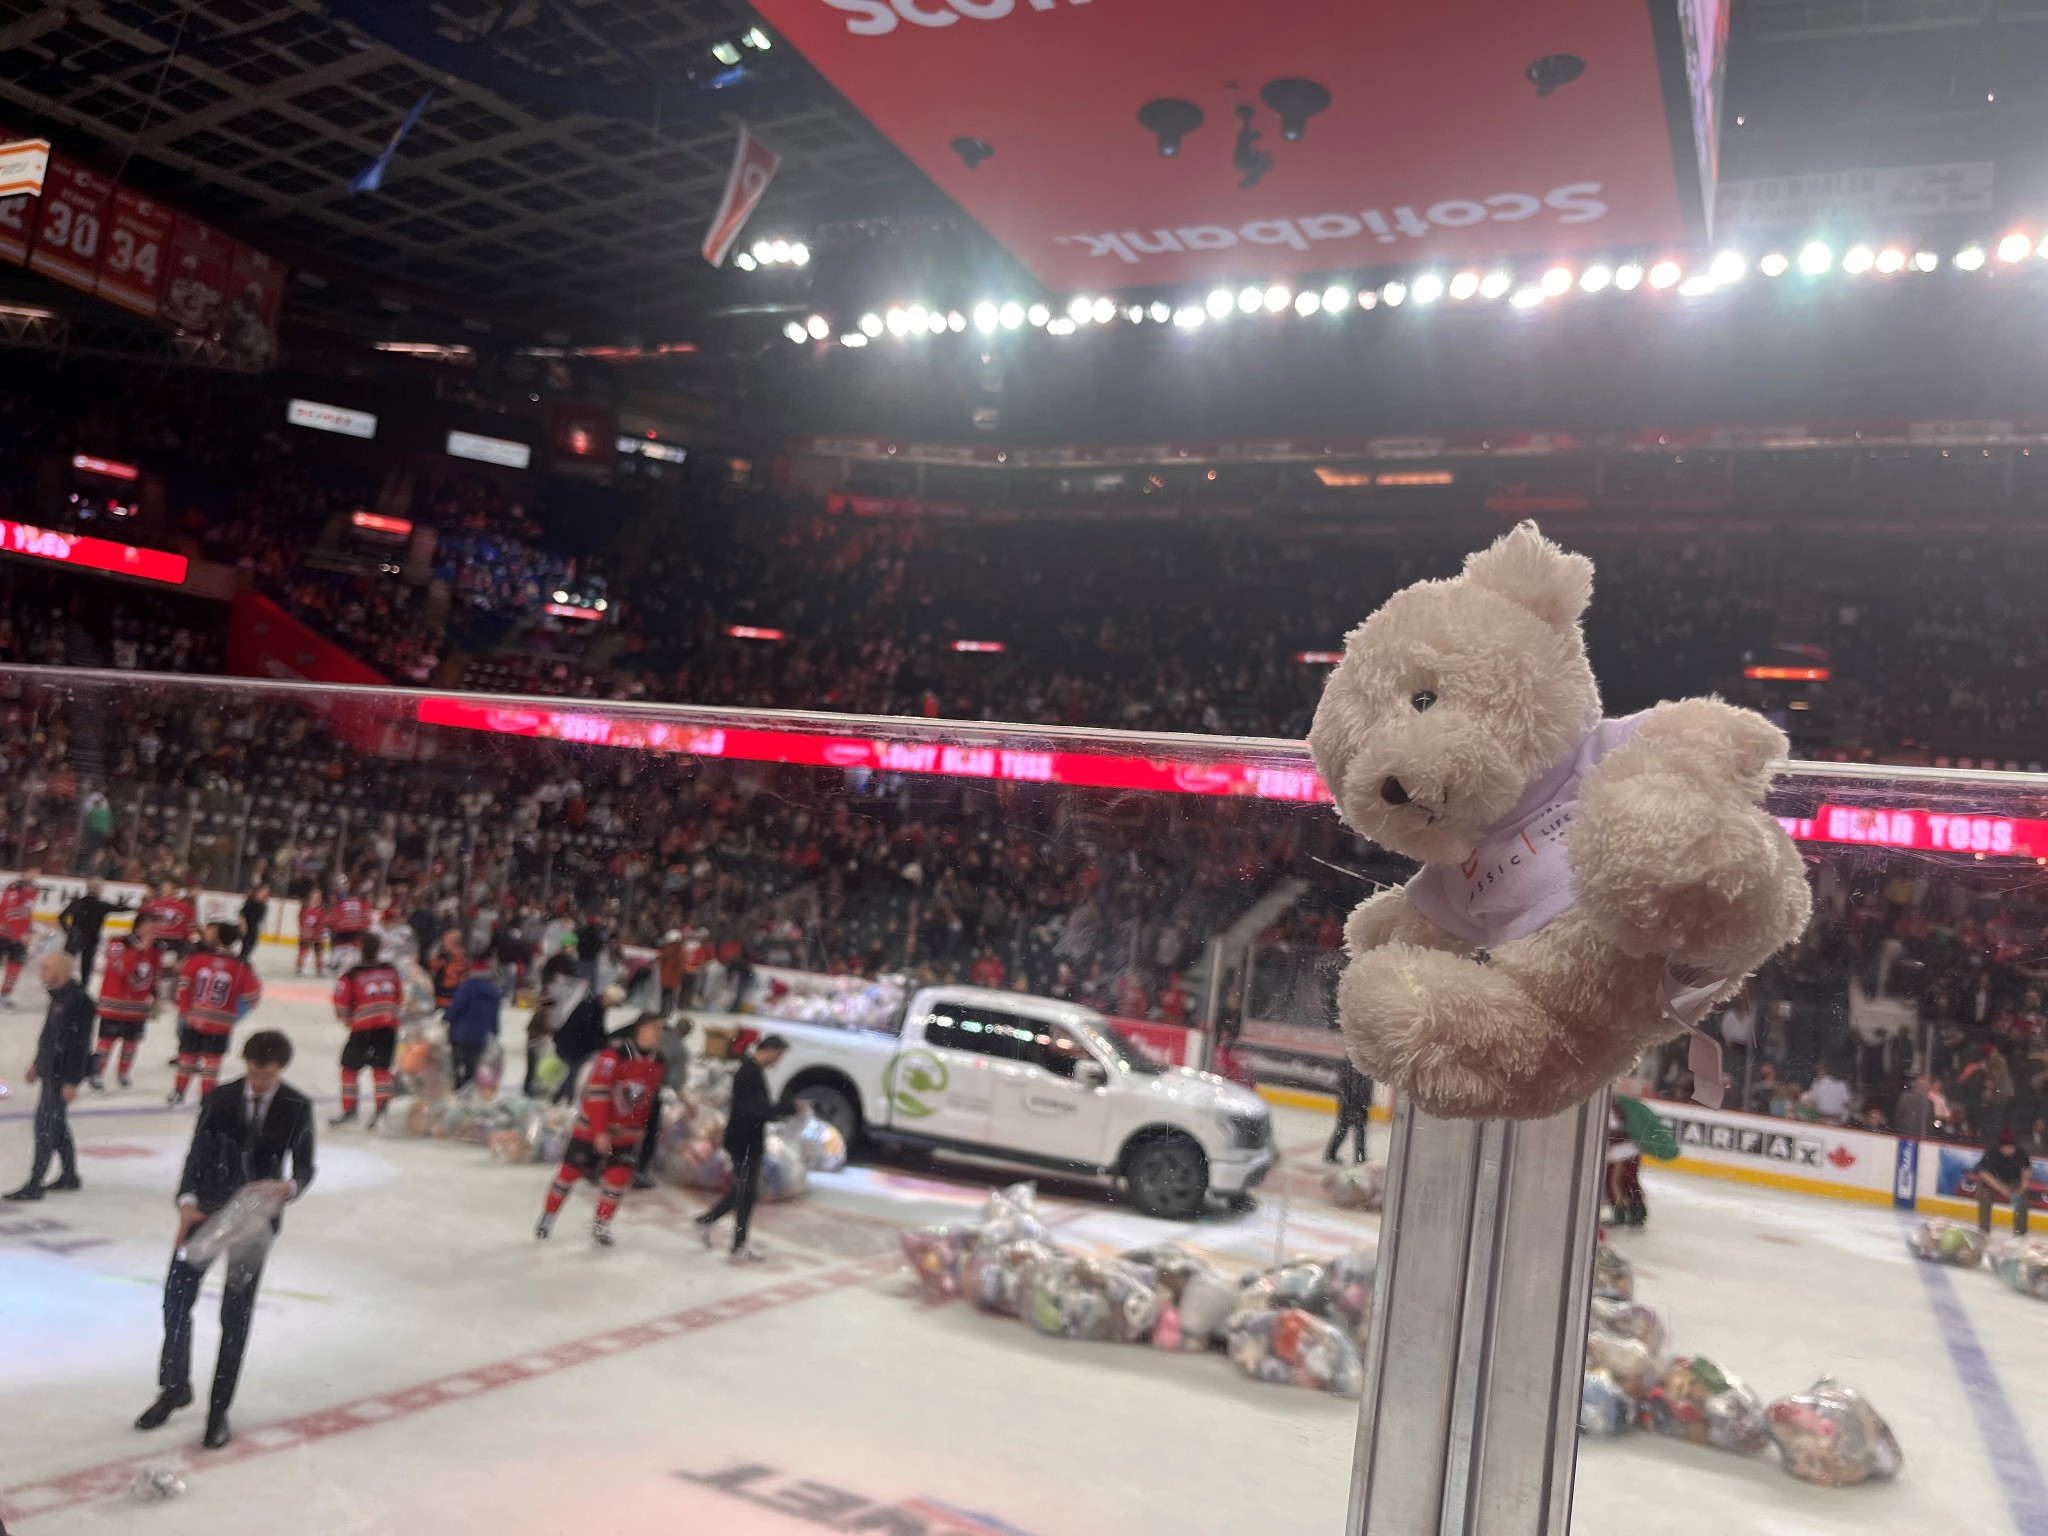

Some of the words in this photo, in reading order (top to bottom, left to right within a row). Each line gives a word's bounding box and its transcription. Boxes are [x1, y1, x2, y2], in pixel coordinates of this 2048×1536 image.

[42, 201, 101, 258] 30
[1074, 181, 1609, 264] Scotiabank
[105, 229, 160, 286] 34
[1541, 813, 1571, 836] LIFE
[1926, 815, 2013, 852] TOSS
[194, 966, 232, 1009] 19
